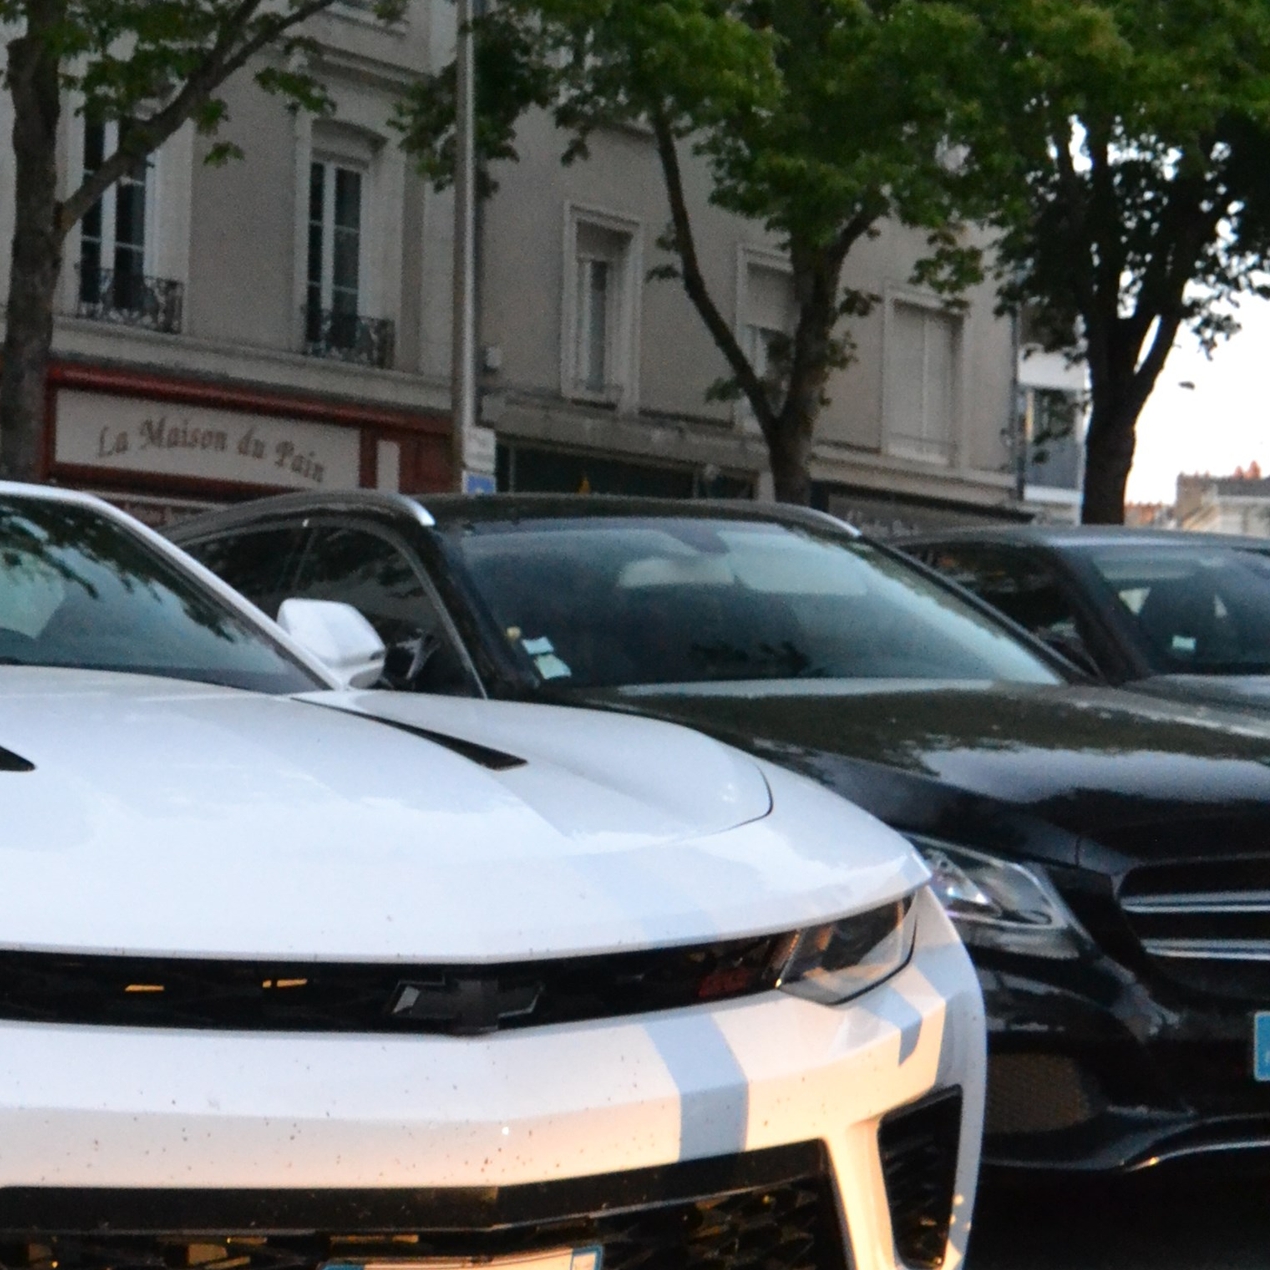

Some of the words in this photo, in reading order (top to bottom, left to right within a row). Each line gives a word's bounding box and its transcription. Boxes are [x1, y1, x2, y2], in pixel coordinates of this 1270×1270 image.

[98, 425, 130, 459] La
[140, 415, 229, 452] Maison
[237, 427, 266, 459] du
[275, 440, 325, 483] Pain
